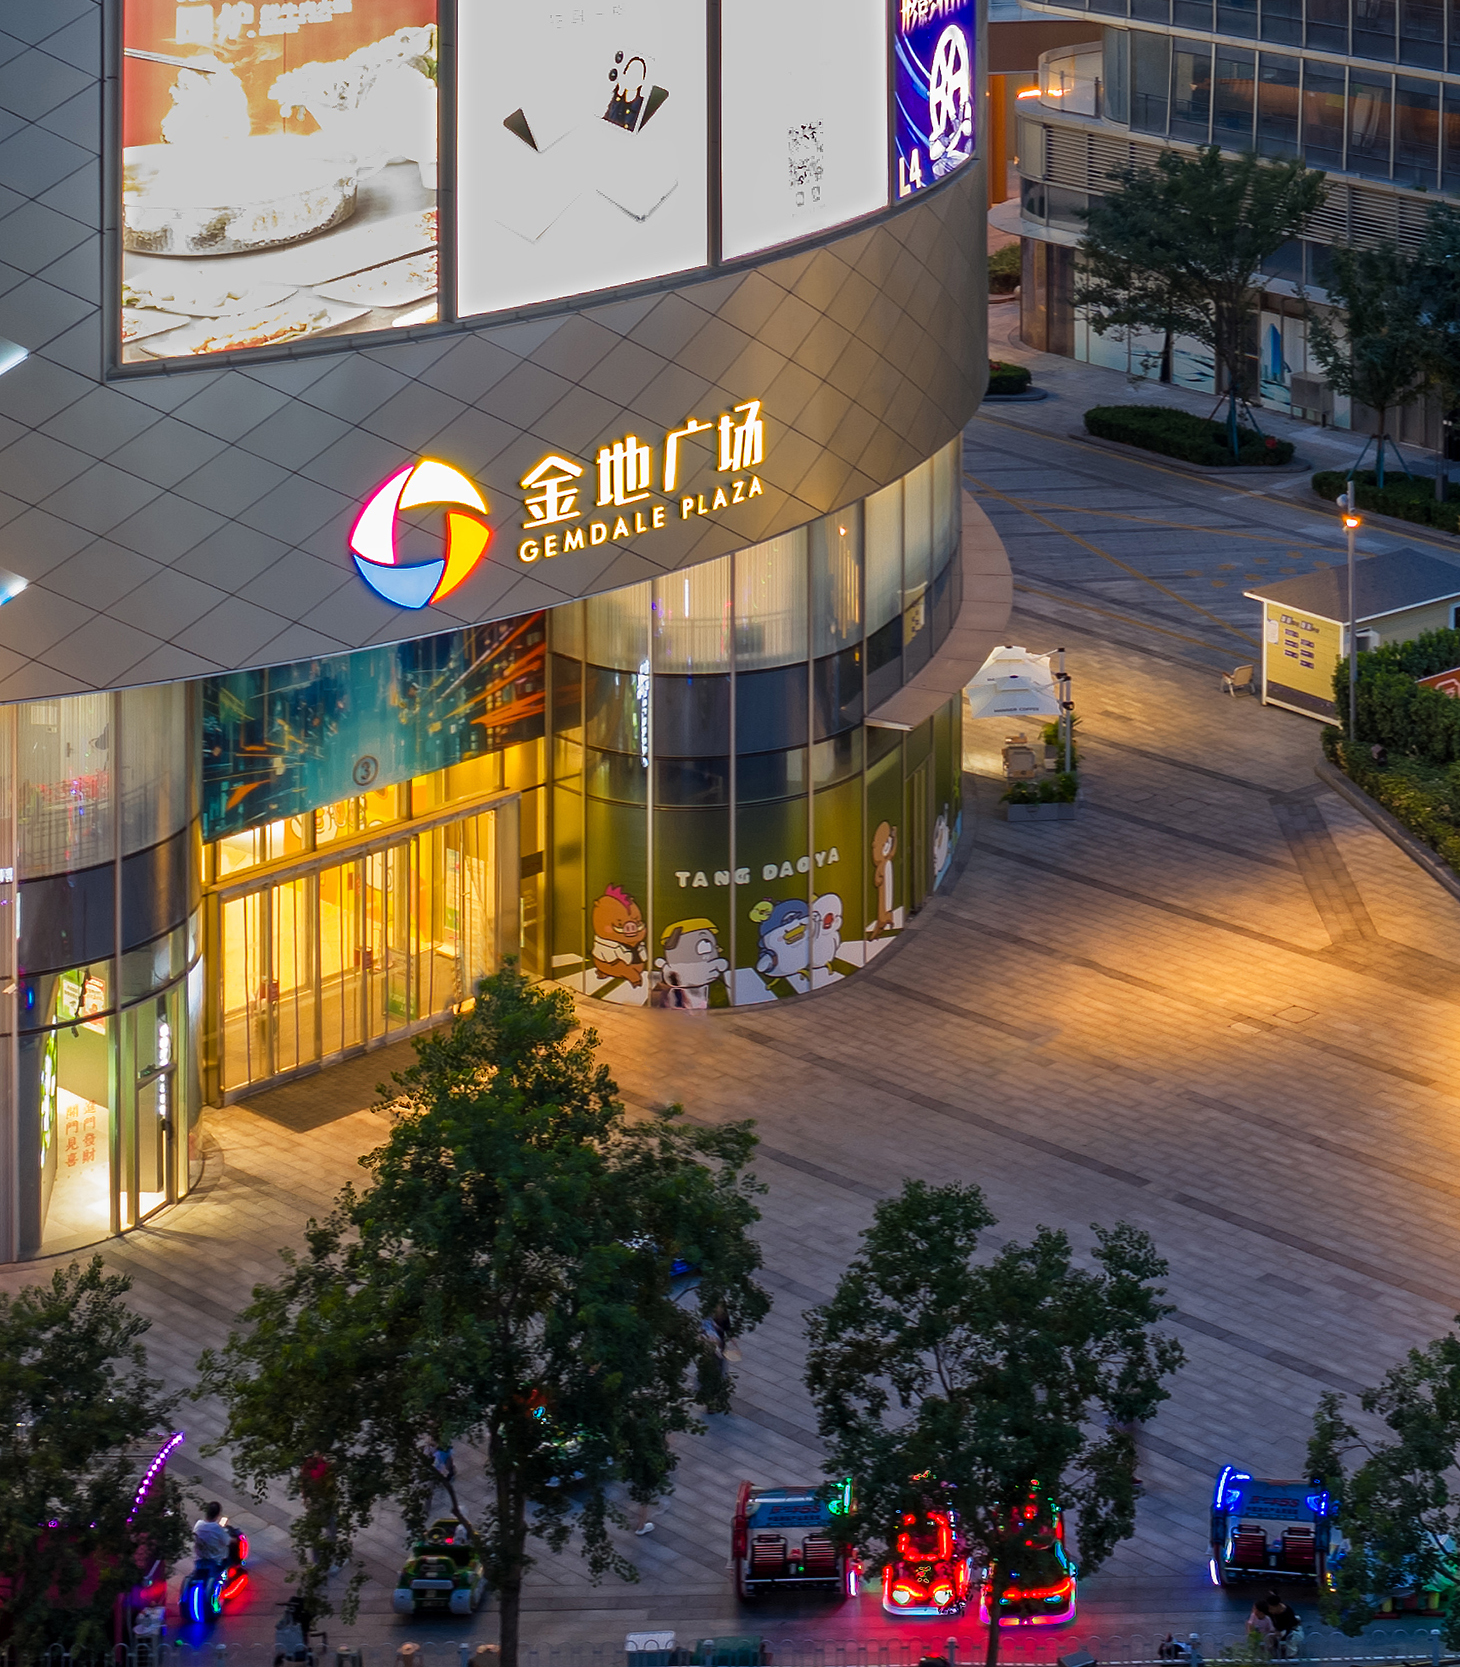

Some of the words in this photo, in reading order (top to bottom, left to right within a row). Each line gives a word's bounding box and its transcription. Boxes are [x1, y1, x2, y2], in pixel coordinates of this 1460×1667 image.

[899, 148, 922, 197] L4
[519, 399, 763, 529] 金地广场
[518, 505, 666, 563] GEMDALE
[681, 475, 763, 519] PLAZA
[675, 867, 750, 888] TANG
[762, 847, 839, 881] DAOYA
